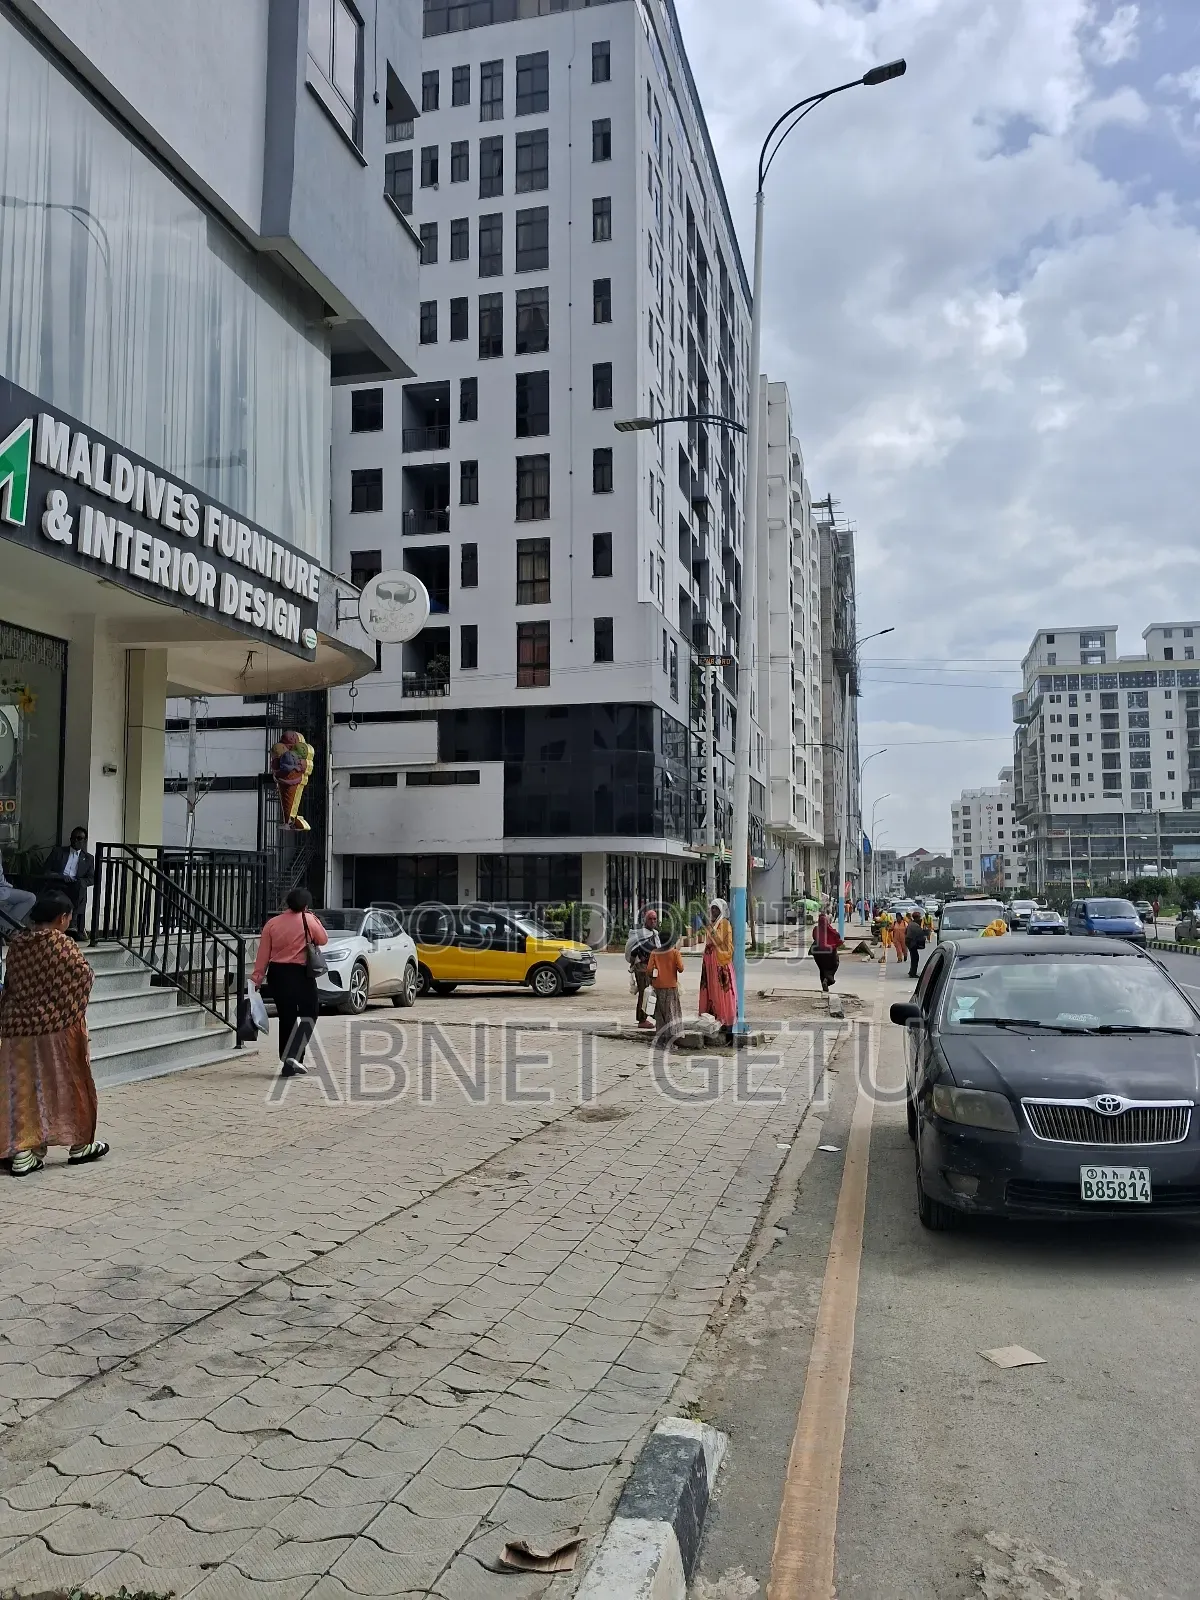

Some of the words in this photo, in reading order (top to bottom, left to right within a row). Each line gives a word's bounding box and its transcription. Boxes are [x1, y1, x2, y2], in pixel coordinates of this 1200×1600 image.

[35, 413, 200, 538] MALDIVES
[203, 505, 321, 603] FURNITURE
[42, 489, 73, 545] &
[77, 505, 217, 608] INTERIOR
[218, 572, 300, 644] DESIGN
[1083, 1180, 1150, 1201] B85814
